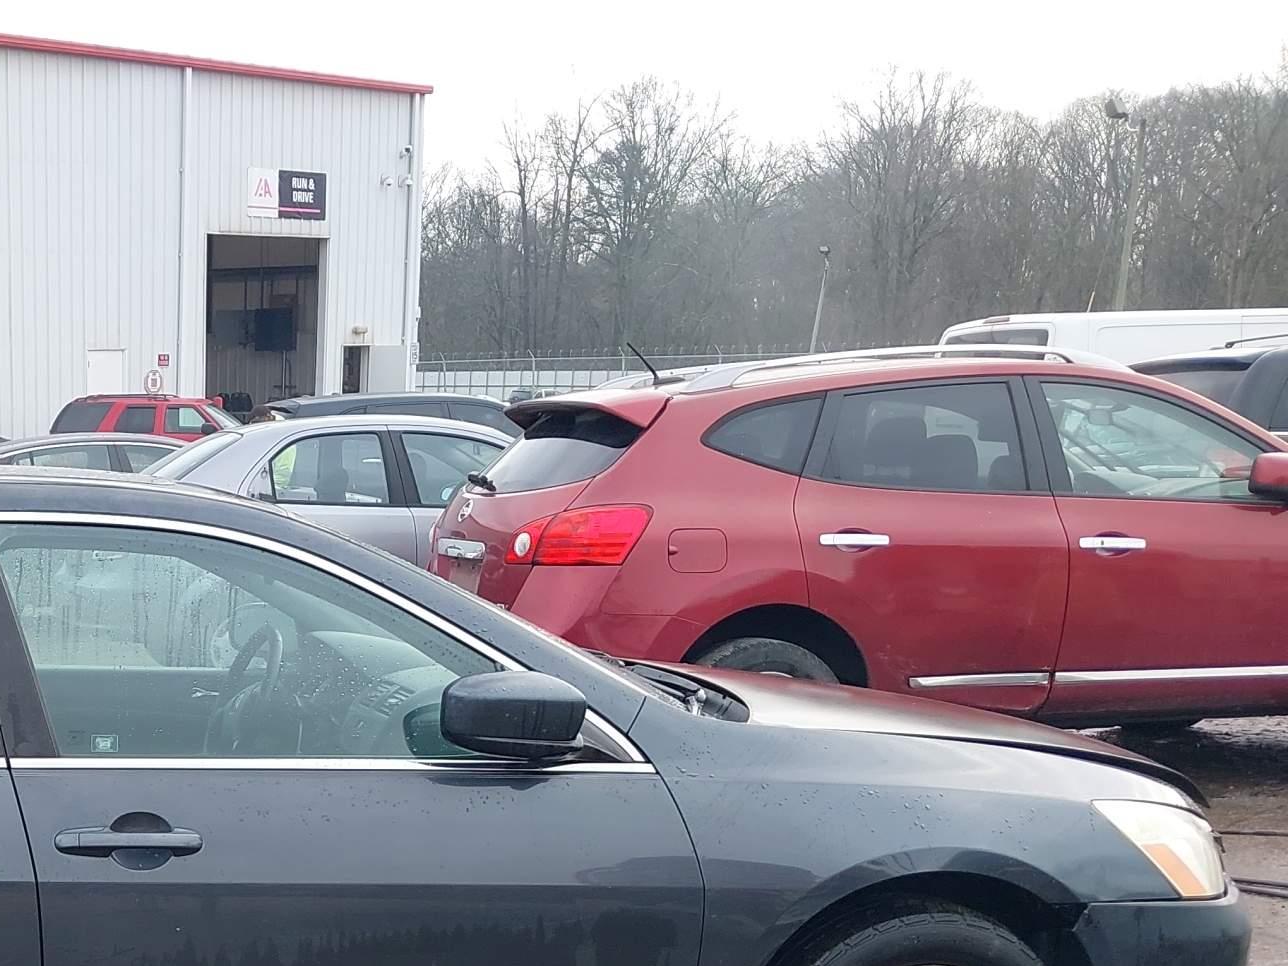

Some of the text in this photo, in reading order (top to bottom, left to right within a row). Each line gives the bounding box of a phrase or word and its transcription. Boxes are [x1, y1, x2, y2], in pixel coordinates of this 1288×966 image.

[292, 177, 315, 190] RUN &
[292, 190, 314, 203] DRIVE
